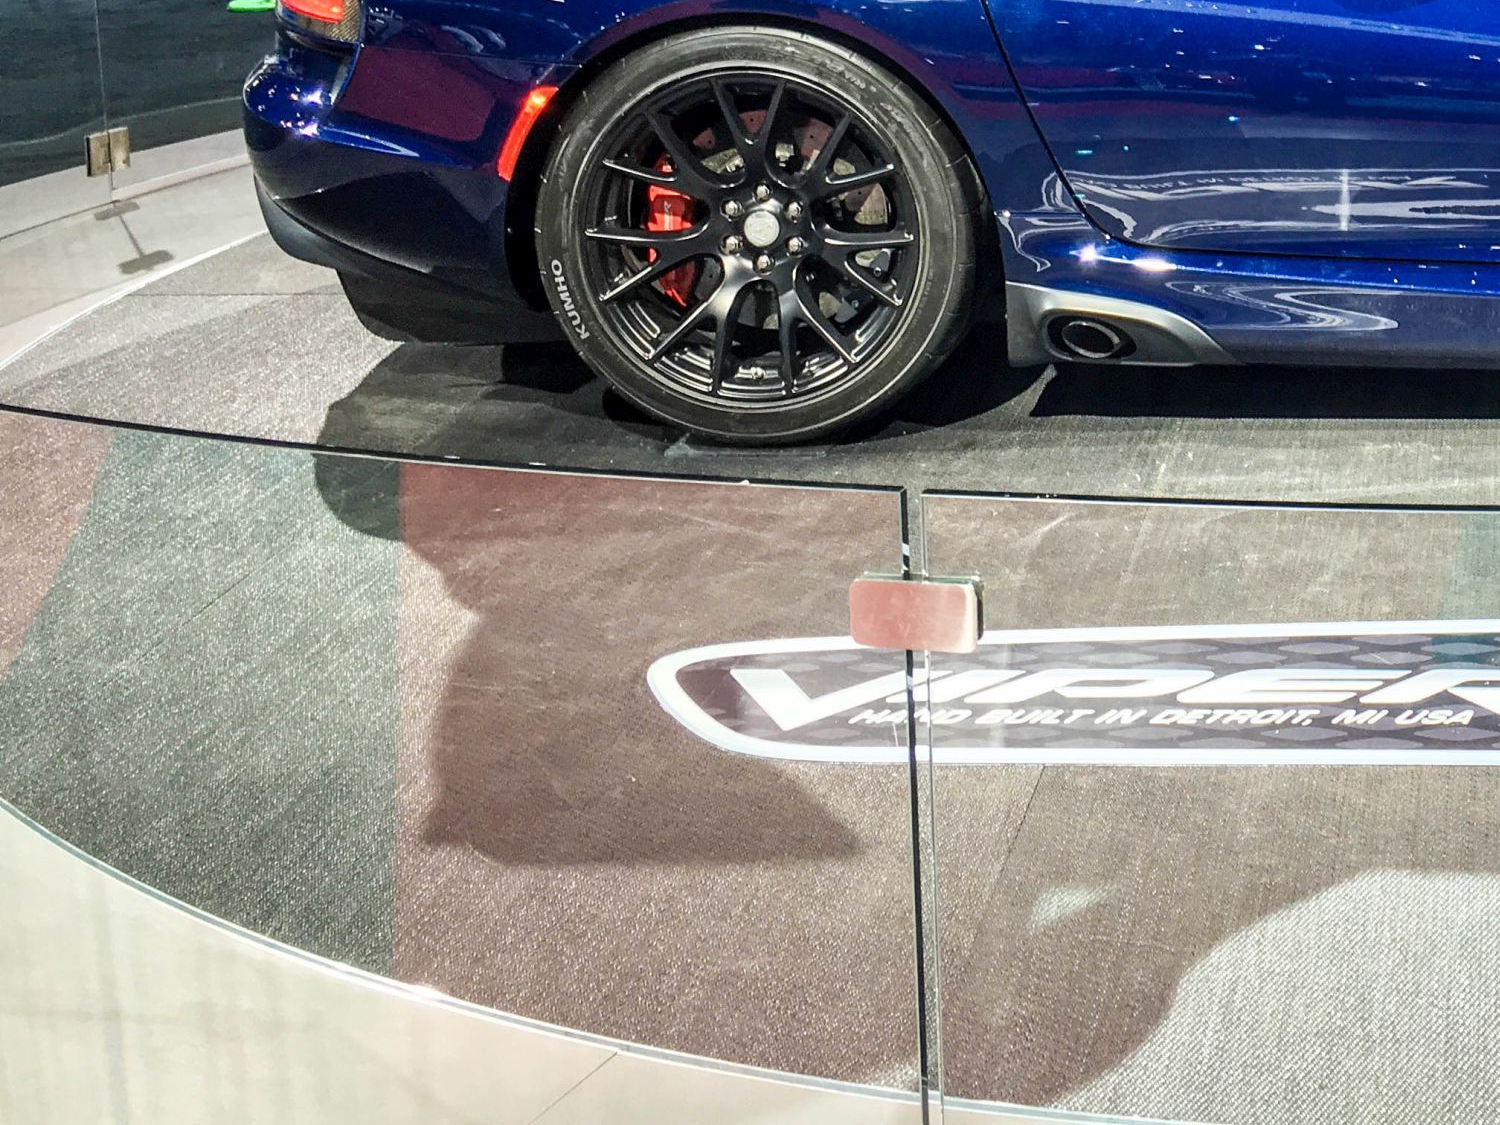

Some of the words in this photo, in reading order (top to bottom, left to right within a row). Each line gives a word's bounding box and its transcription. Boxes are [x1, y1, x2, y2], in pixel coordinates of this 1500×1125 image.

[551, 259, 590, 339] KUMHO
[848, 708, 966, 725] HAND
[975, 708, 1096, 725] BUILT
[1093, 708, 1147, 725] IN
[1149, 708, 1321, 726] DETROIT,
[1332, 709, 1392, 725] MI
[1394, 709, 1475, 725] USA
